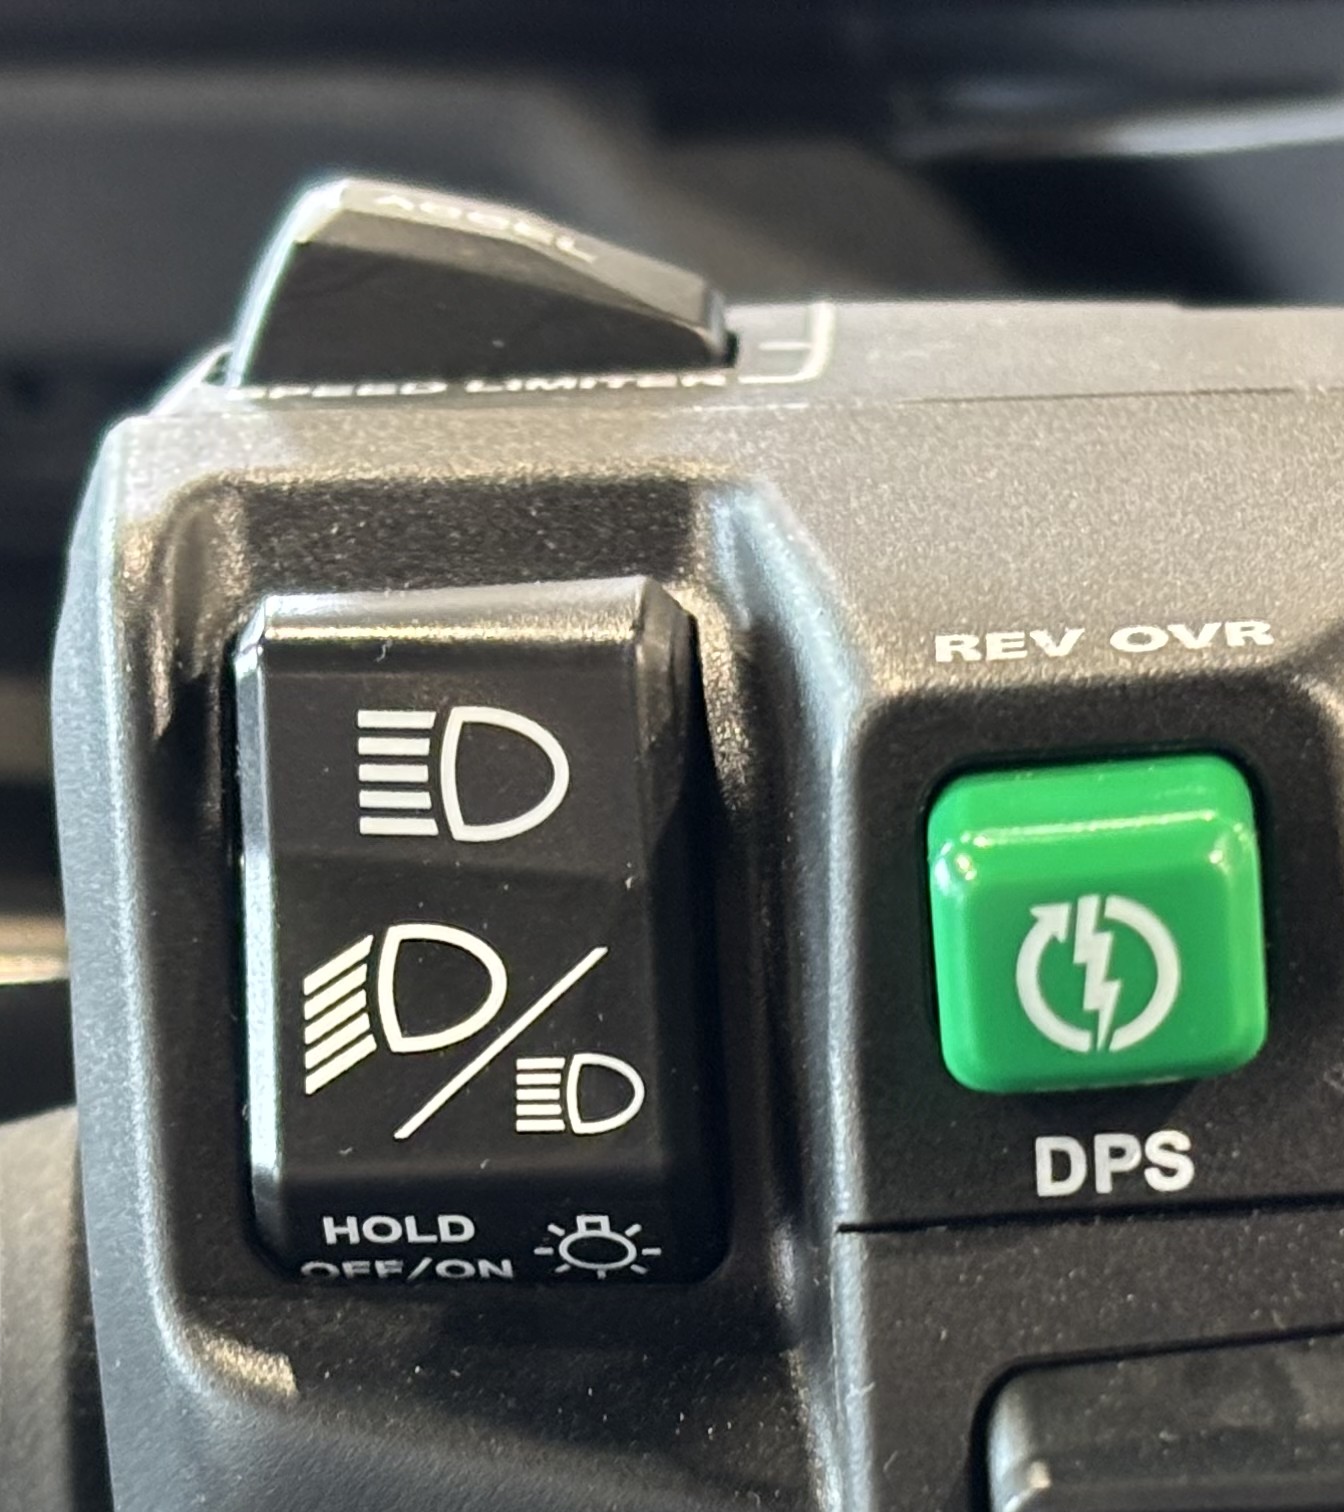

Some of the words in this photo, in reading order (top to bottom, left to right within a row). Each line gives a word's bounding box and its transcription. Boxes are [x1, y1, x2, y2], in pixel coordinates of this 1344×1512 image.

[935, 628, 1085, 662] REV
[1109, 619, 1275, 653] OVR
[1035, 1129, 1196, 1197] DPS
[322, 1214, 476, 1245] HOLD
[301, 1256, 514, 1280] OFF/ON
